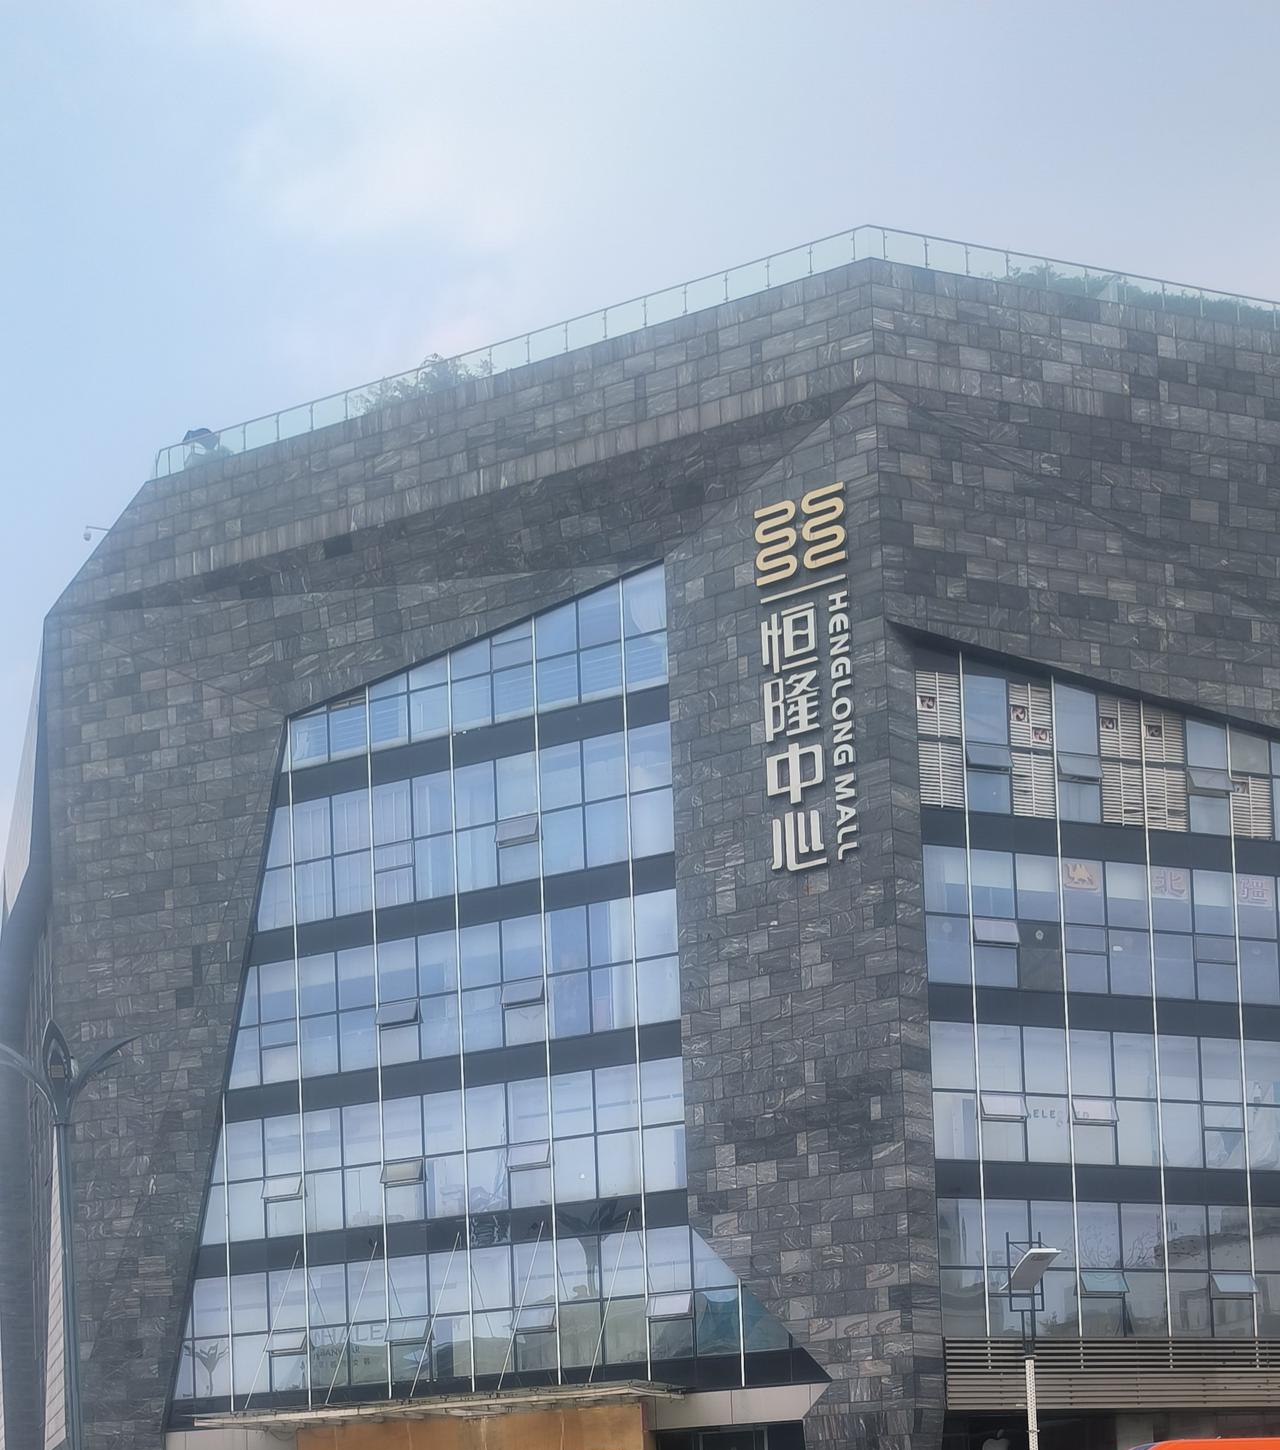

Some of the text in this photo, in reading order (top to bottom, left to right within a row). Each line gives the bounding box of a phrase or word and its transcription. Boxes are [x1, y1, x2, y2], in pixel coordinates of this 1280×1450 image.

[760, 602, 828, 872] 恒隆中心
[828, 589, 860, 861] HENGLONG MALL
